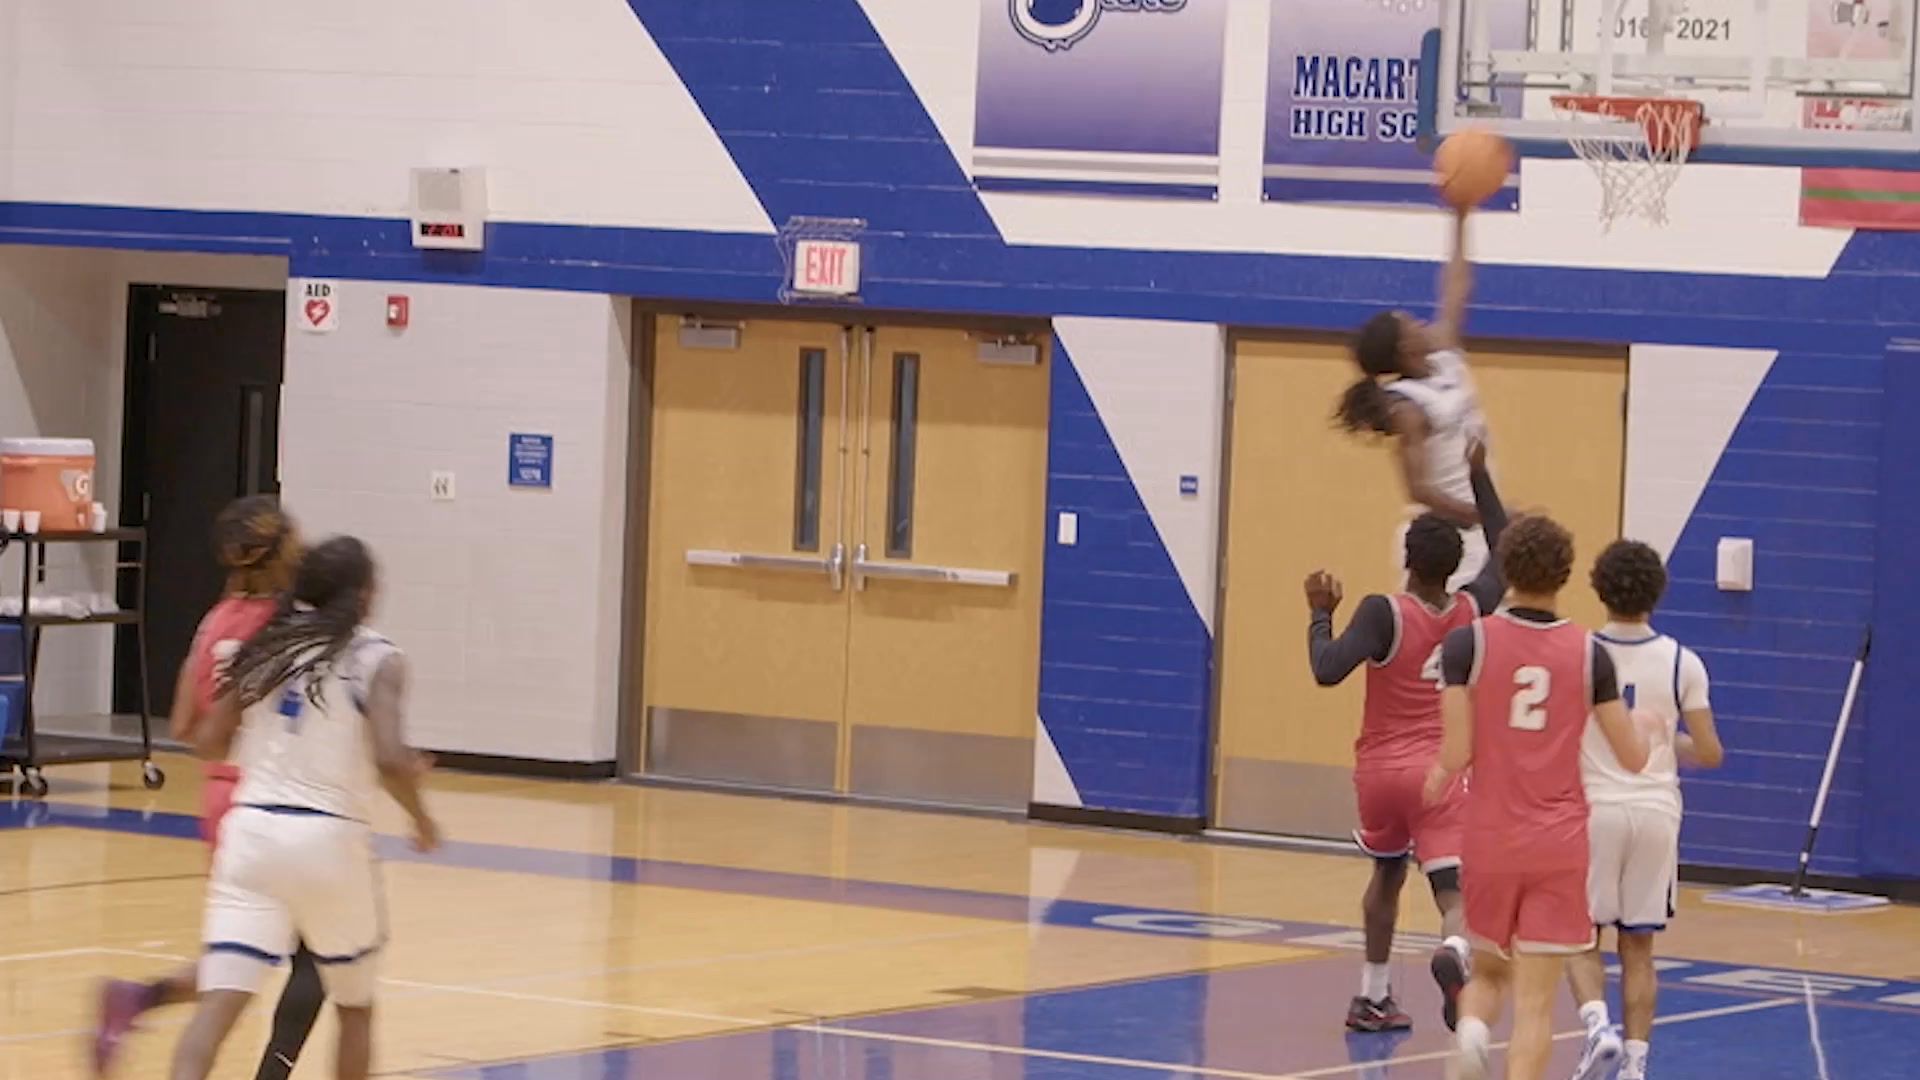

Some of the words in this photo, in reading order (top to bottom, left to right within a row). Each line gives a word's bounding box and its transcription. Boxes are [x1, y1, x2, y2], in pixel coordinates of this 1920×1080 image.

[1676, 17, 1731, 41] 2021
[1292, 107, 1367, 137] HIGH
[805, 246, 847, 286] EXIT
[305, 283, 331, 297] AED
[1507, 664, 1551, 731] 2
